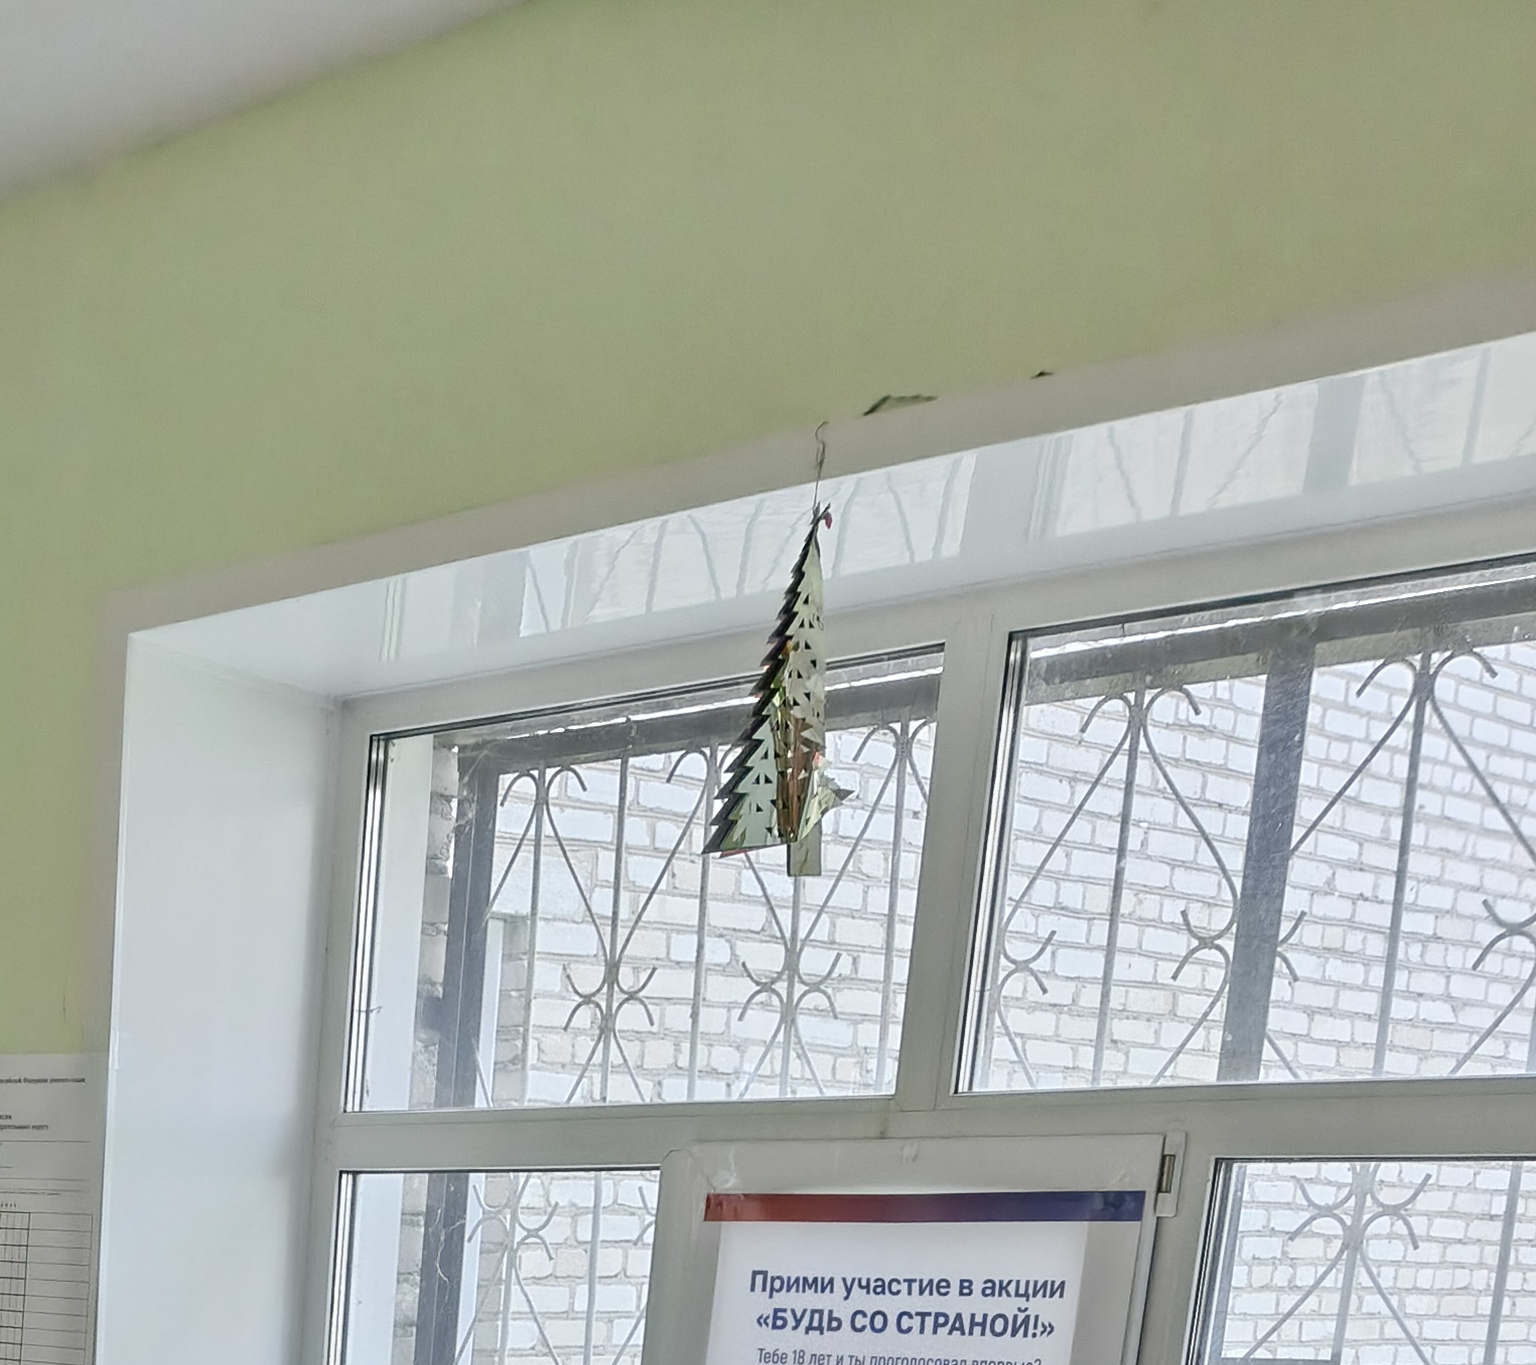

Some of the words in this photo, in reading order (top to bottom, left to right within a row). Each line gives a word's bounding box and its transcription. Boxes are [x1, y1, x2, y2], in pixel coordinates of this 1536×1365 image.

[749, 1269, 835, 1299] Прими
[841, 1276, 952, 1301] участие
[958, 1279, 974, 1297] в
[980, 1278, 1067, 1302] акции
[755, 1307, 843, 1335] «БУДЬ
[850, 1310, 888, 1334] СО
[895, 1307, 1055, 1339] СТРАНОЙ!»
[757, 1347, 788, 1365] Тебе
[791, 1350, 806, 1365] 18
